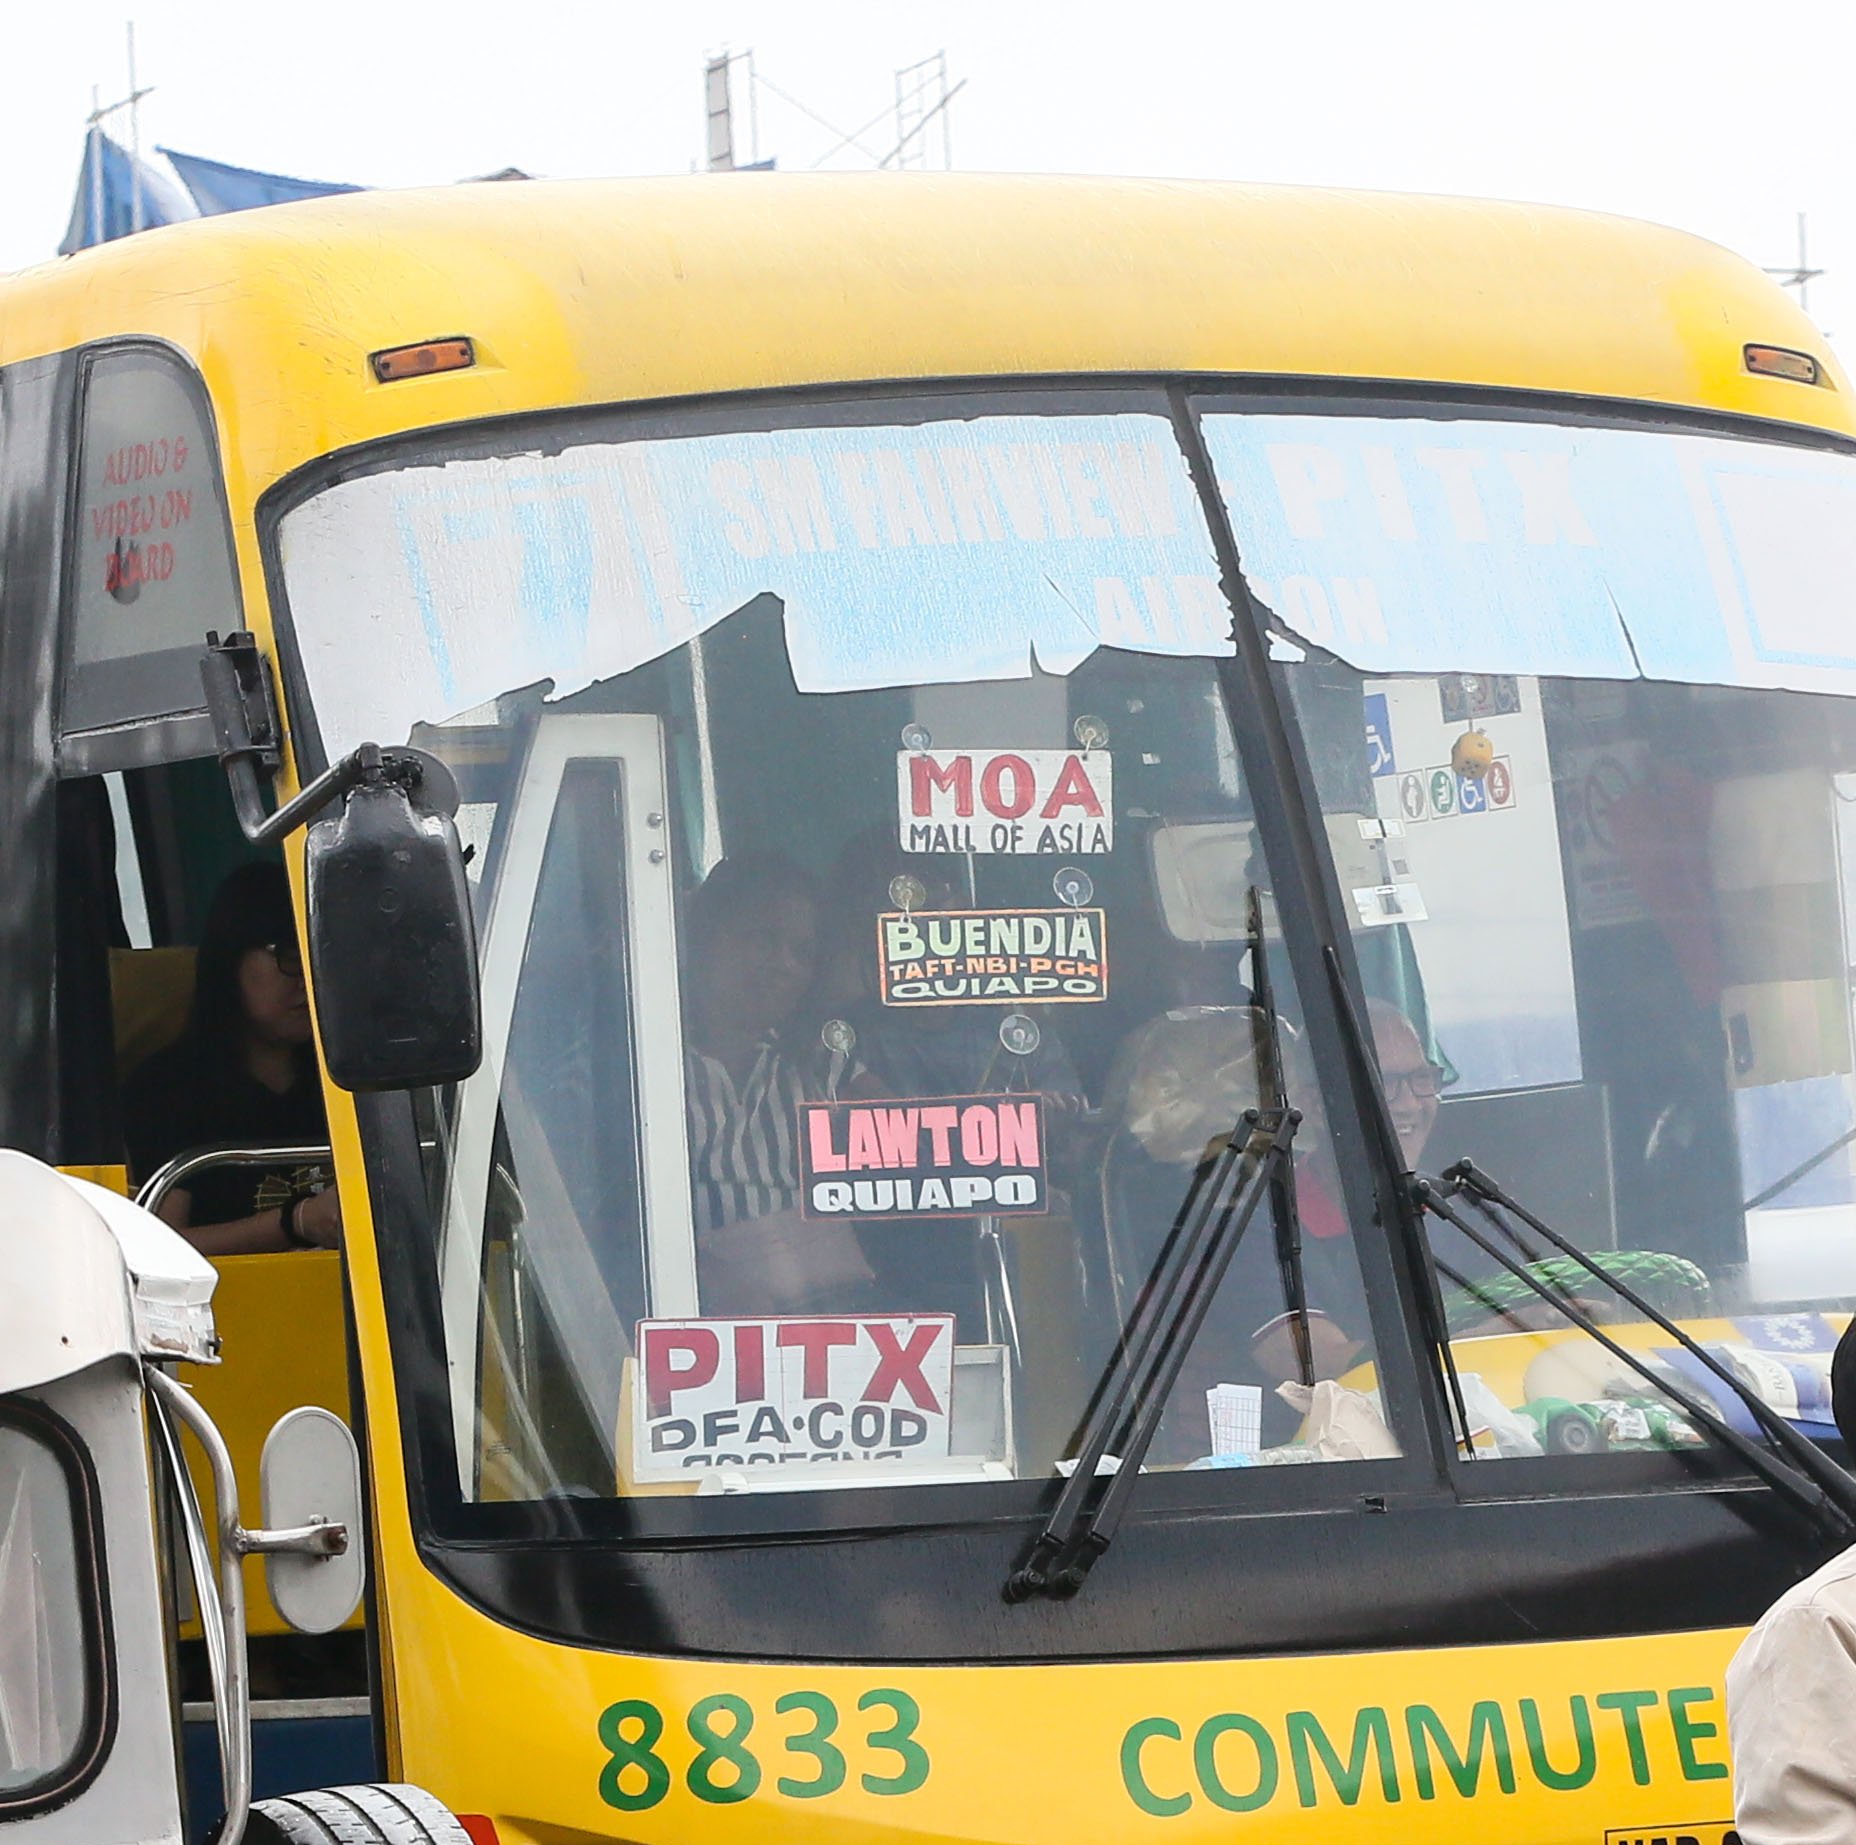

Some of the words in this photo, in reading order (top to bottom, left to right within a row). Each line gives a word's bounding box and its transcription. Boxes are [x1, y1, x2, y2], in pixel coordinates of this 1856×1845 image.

[94, 496, 153, 541] VIDEO
[160, 490, 193, 531] ON
[714, 456, 836, 559] SM
[834, 440, 1180, 549] FAIRVIEW
[1265, 441, 1599, 548] PITX
[1097, 574, 1389, 648] AIRON
[909, 754, 1103, 819] MOA
[909, 824, 976, 853] MALL
[990, 825, 1025, 852] OF
[1036, 823, 1109, 853] ASIA
[887, 916, 1098, 962] BUENDIA
[889, 957, 1099, 980] TAFT-NBI-PGH
[890, 977, 1098, 998] QUIAPO
[807, 1103, 1041, 1172] LAWTON
[812, 1175, 1038, 1213] QUIAPO
[644, 1322, 945, 1421] PITX
[596, 1687, 932, 1812] 8833
[1119, 1683, 1730, 1817] COMMUTE
